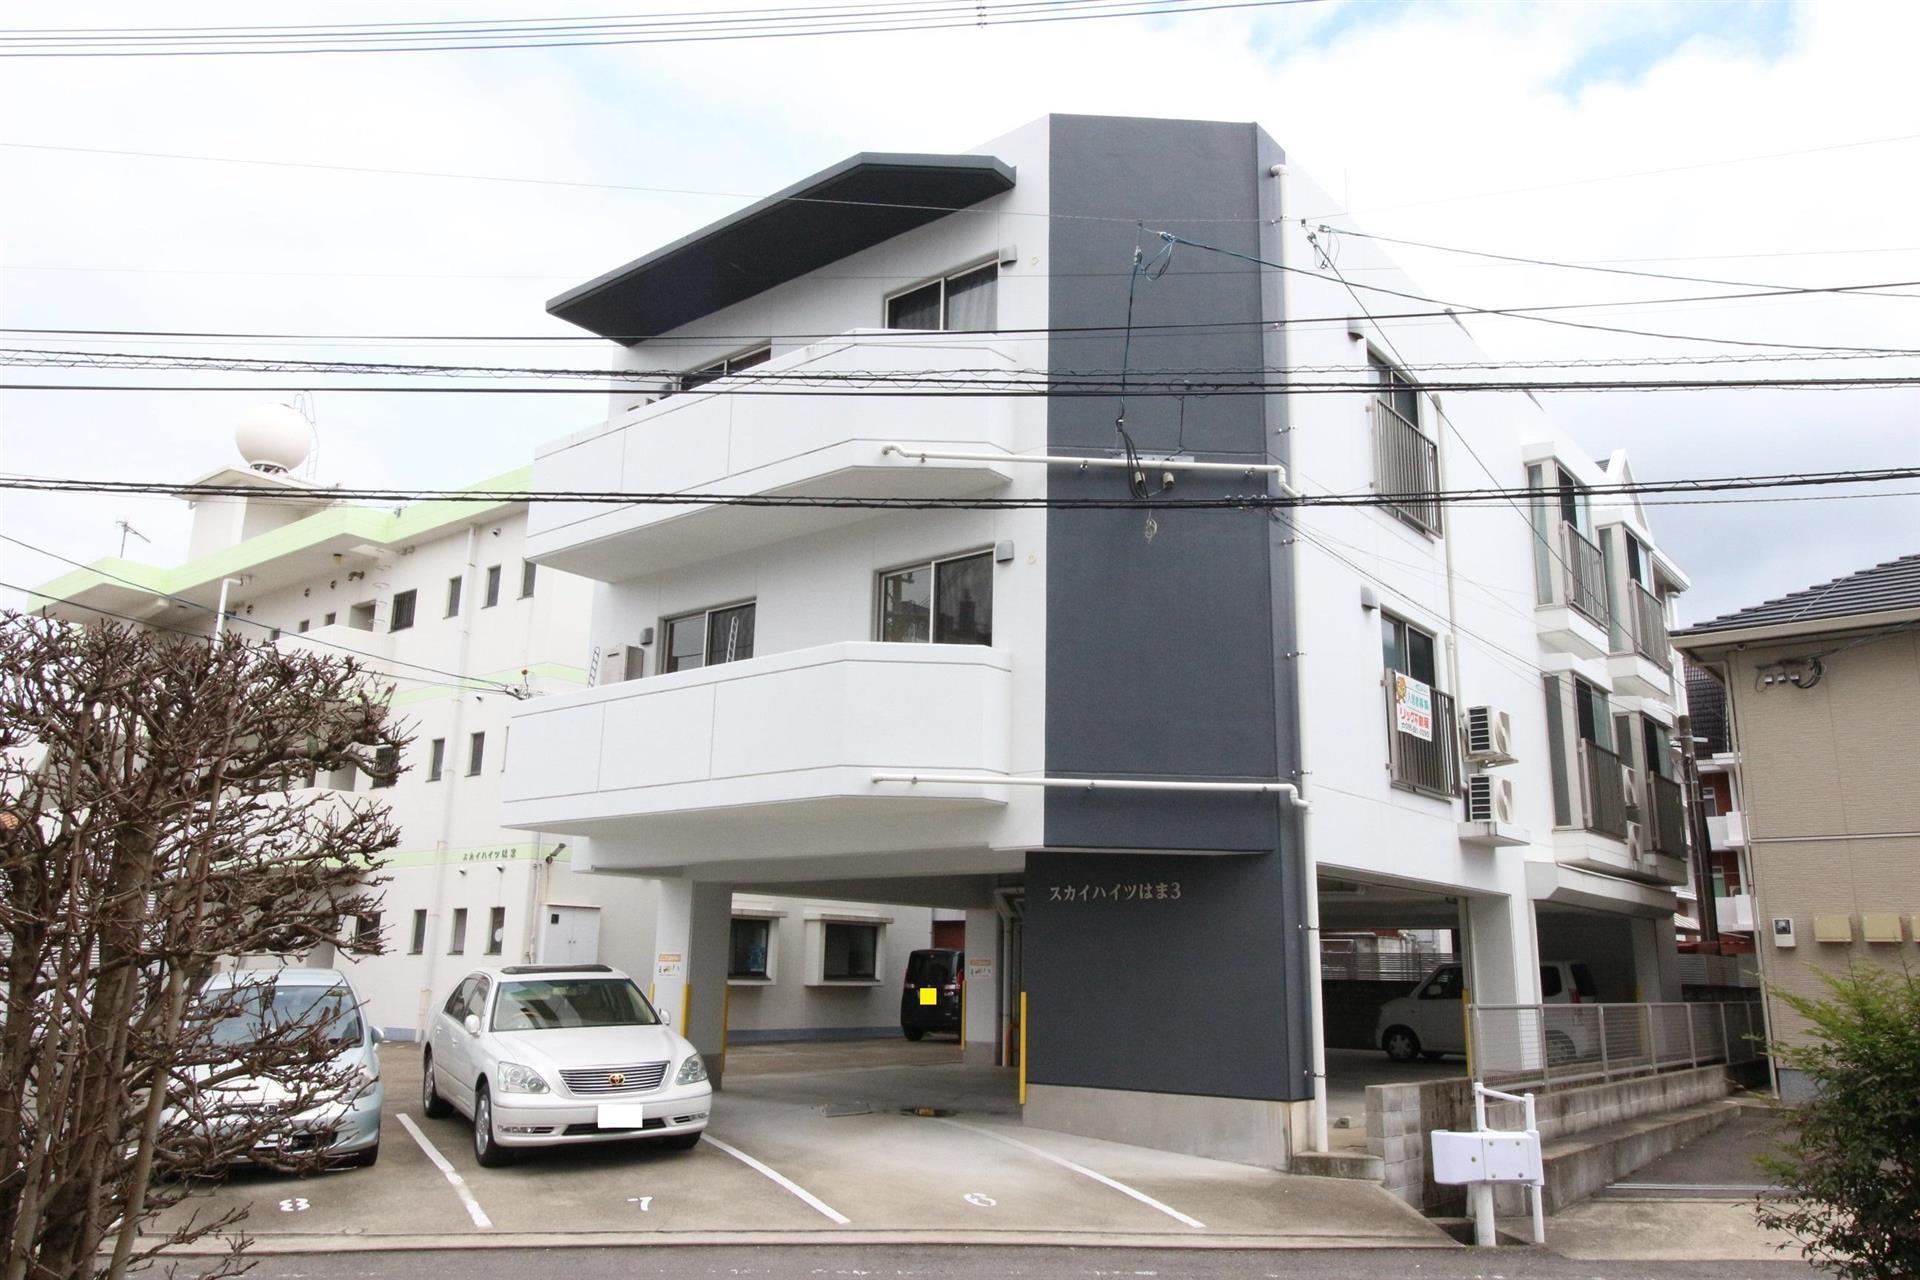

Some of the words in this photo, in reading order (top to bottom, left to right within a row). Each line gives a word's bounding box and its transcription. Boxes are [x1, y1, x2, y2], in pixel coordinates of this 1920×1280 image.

[1049, 881, 1182, 901] スカイハイツはま3
[626, 1196, 653, 1211] 7
